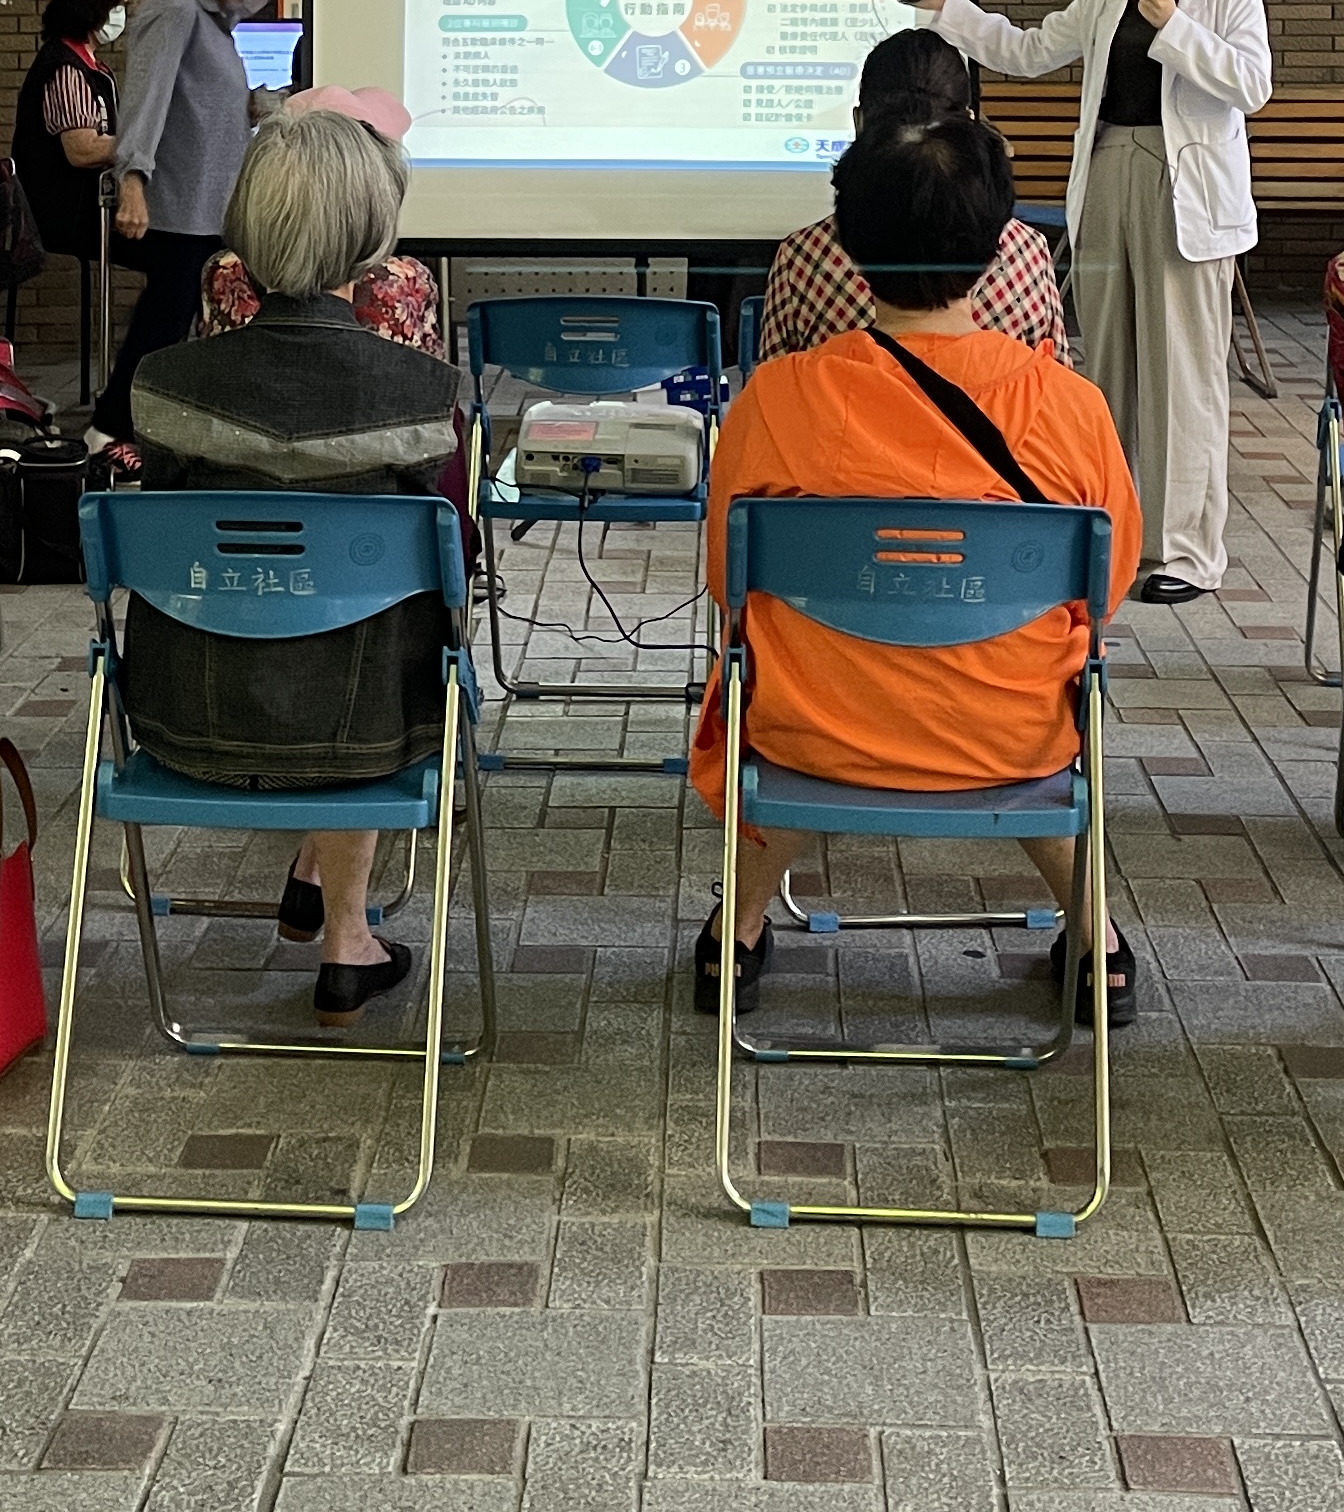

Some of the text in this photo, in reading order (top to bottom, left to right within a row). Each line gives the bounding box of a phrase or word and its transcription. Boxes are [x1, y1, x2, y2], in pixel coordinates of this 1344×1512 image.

[624, 3, 685, 16] 行動指南
[544, 341, 631, 368] 自立社區
[190, 561, 317, 596] 自立社區
[857, 565, 986, 603] 自立社區
